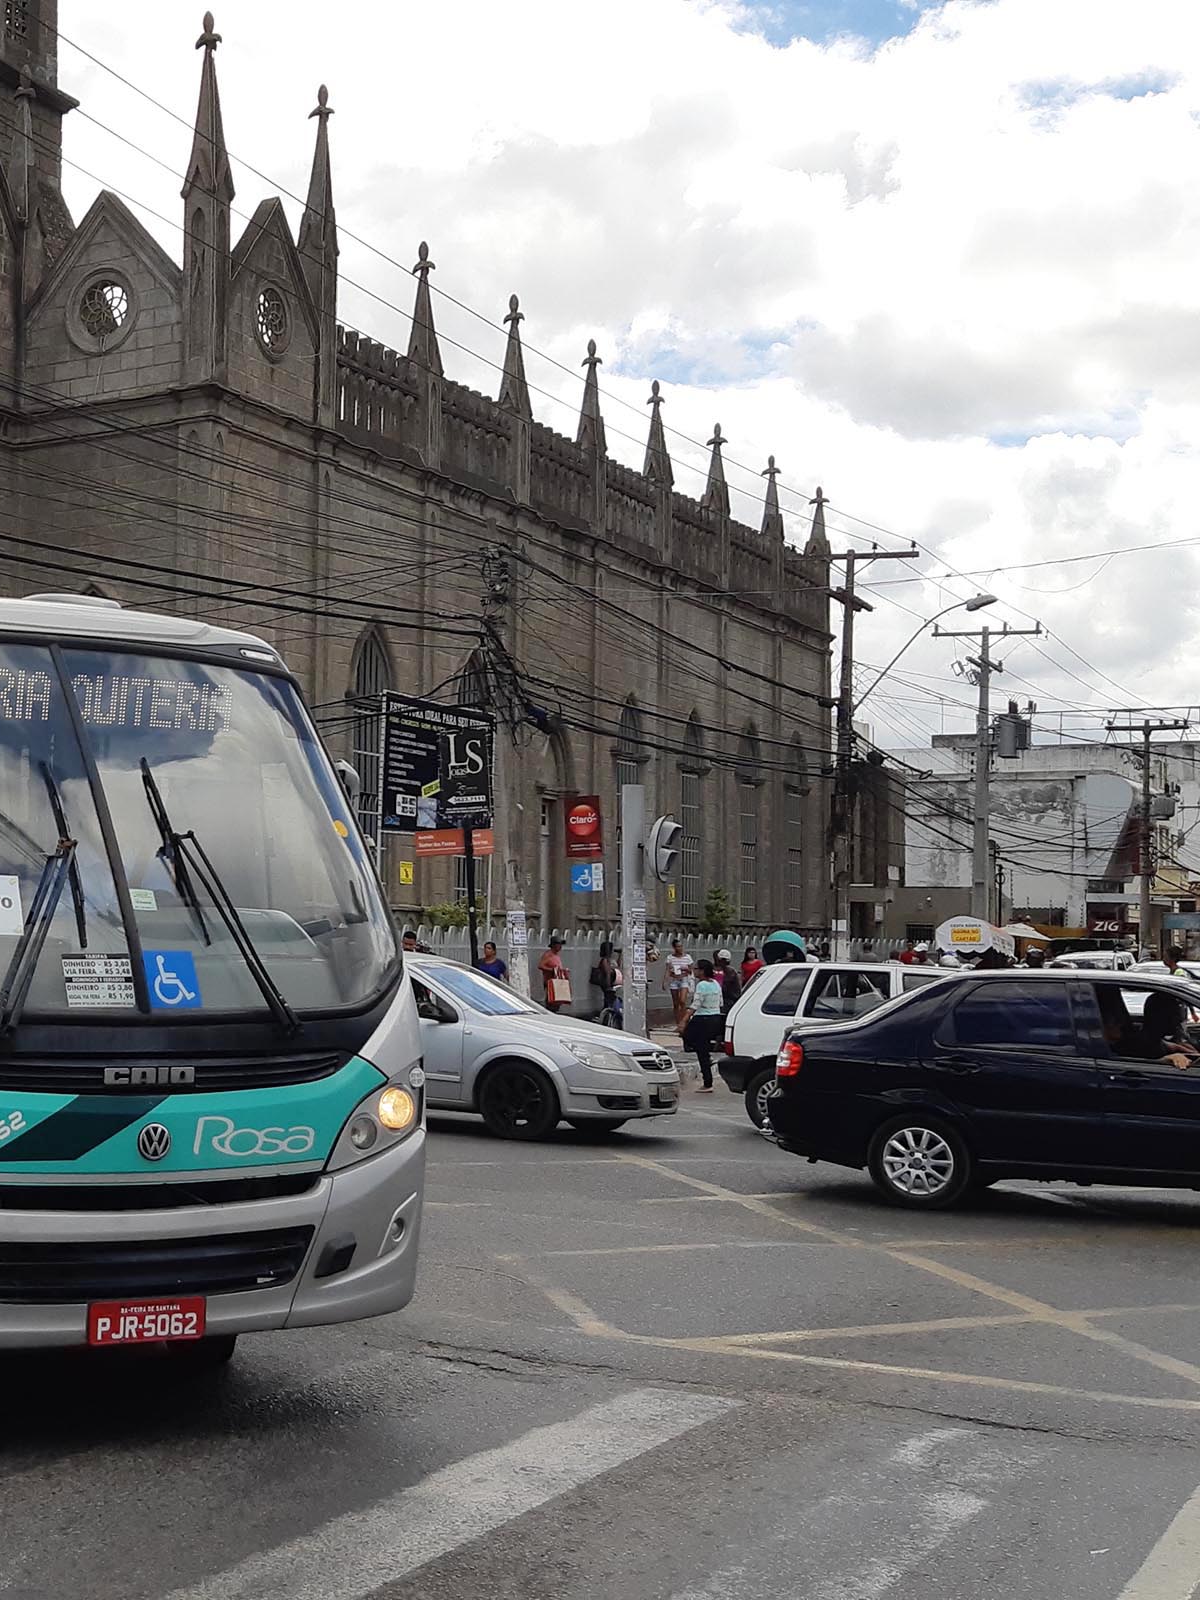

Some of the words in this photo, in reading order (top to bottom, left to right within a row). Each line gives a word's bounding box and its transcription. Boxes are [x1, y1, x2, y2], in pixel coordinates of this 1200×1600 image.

[70, 672, 234, 733] QUITERIA
[442, 713, 457, 727] PARA
[569, 815, 593, 825] Claro
[1093, 921, 1119, 932] ZIG
[63, 960, 96, 968] DINHEIRO
[114, 960, 130, 969] 3,80
[66, 984, 100, 992] DINHEIRO
[103, 1066, 196, 1085] CAIO
[192, 1115, 316, 1157] Rosa
[155, 1304, 181, 1312] SANTANA
